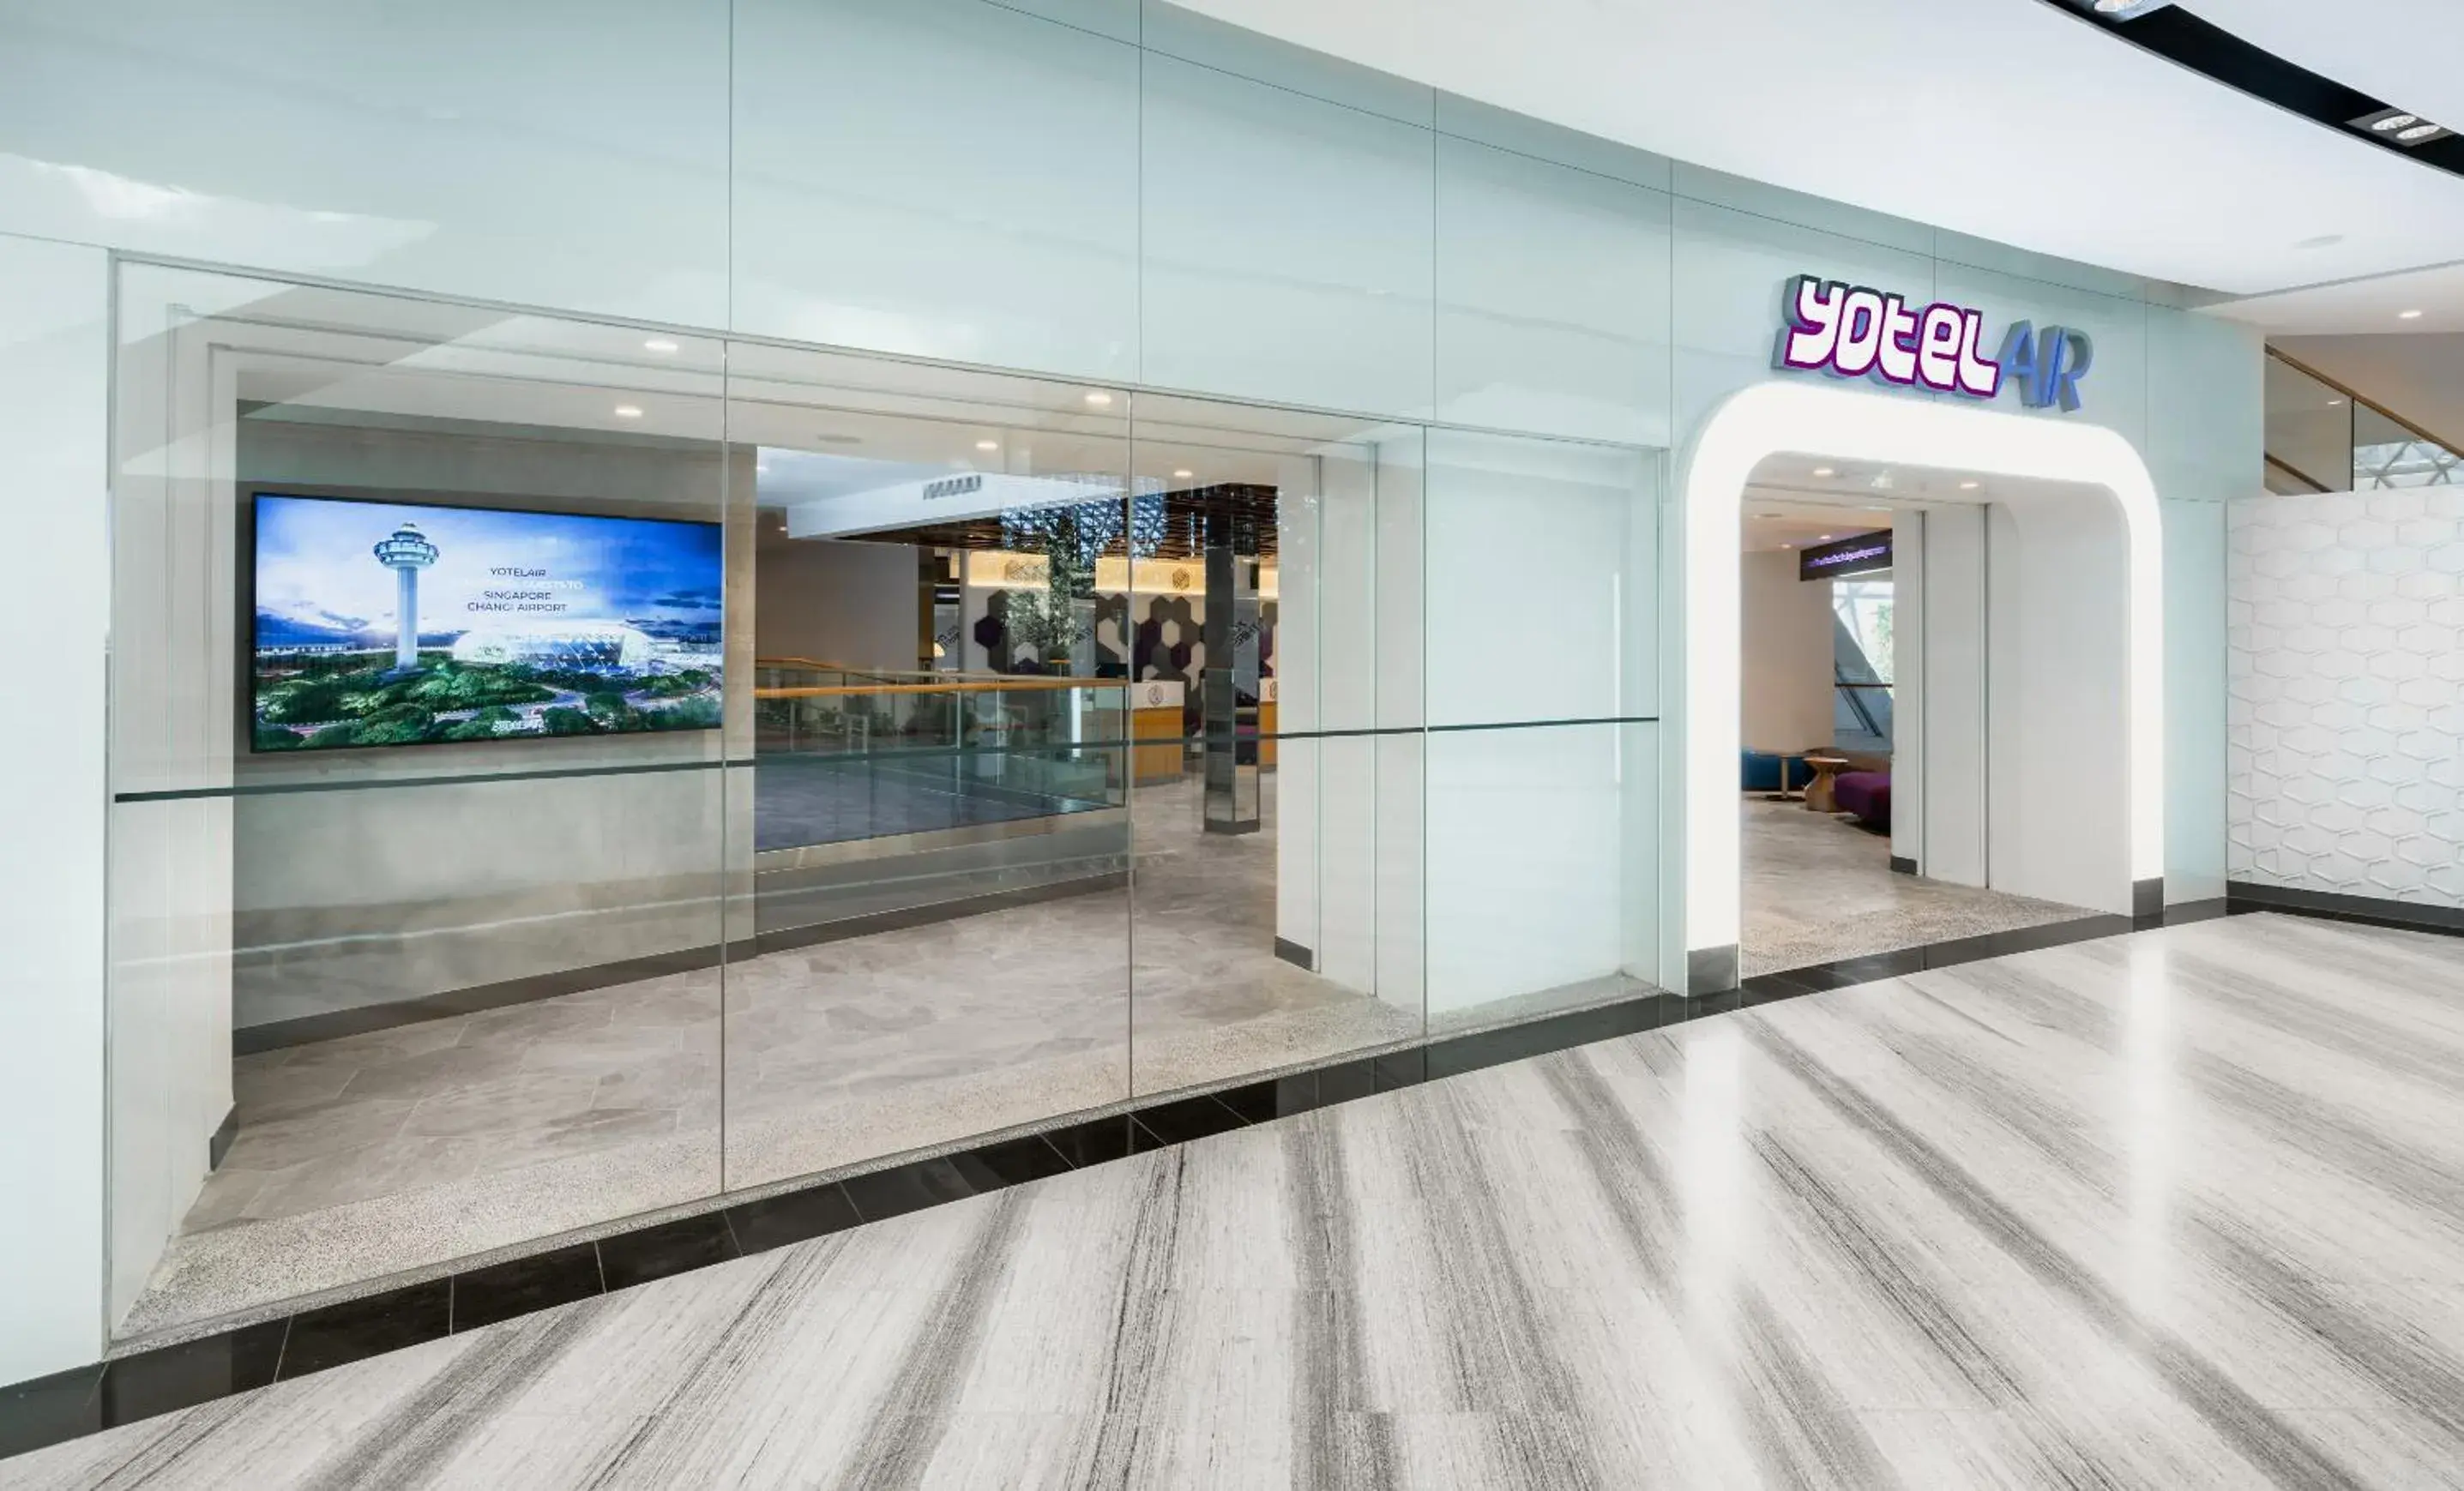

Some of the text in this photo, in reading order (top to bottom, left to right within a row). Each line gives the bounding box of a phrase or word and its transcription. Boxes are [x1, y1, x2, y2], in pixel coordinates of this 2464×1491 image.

[490, 567, 546, 577] YOTELAIR
[484, 590, 551, 601] SINGAPORE
[517, 603, 568, 612] AIRPORT
